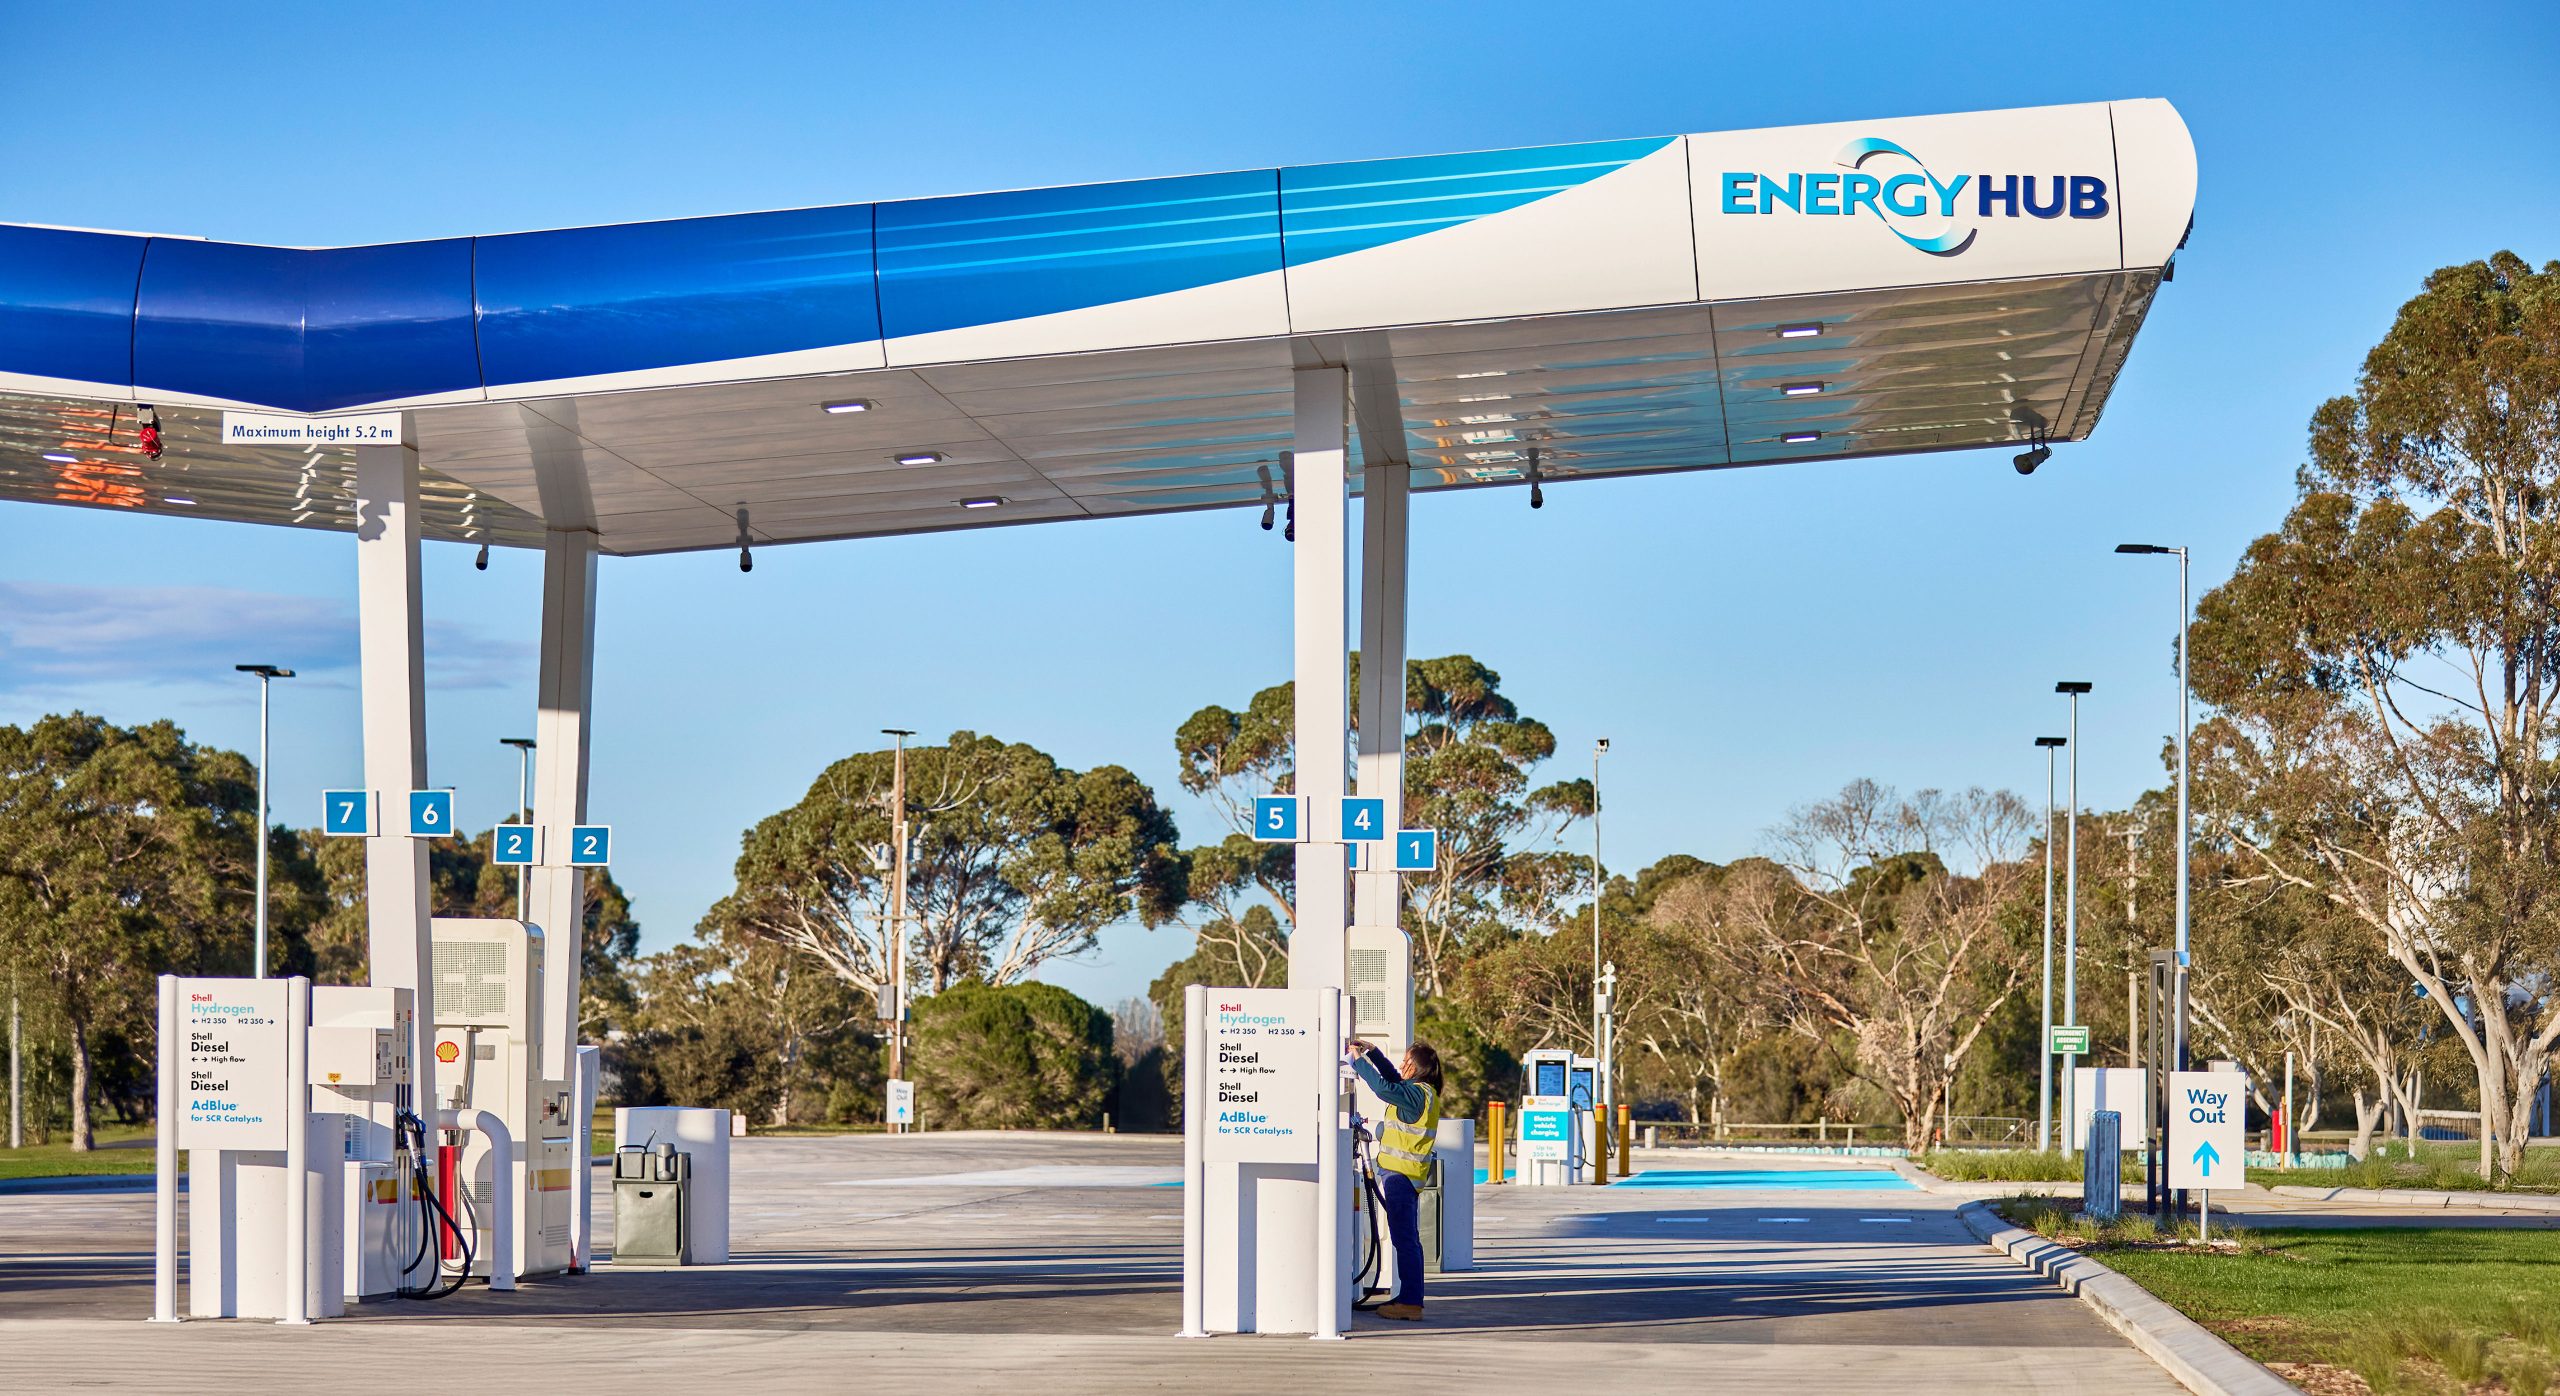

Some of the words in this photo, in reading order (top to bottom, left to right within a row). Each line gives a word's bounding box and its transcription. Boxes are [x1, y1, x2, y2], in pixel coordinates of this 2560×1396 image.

[1721, 171, 1972, 217] ENERGY
[1978, 174, 2110, 219] HUB
[232, 424, 301, 438] Maximum
[307, 424, 350, 441] height
[355, 425, 377, 438] 5.2
[381, 428, 393, 438] m
[338, 801, 354, 824] 7
[422, 802, 439, 825] 6
[1268, 807, 1284, 830] 5
[1354, 808, 1371, 831] 4
[507, 834, 522, 854] 2
[583, 835, 598, 855] 2
[1409, 840, 1420, 860] 1
[191, 994, 213, 1002] Shell
[191, 1003, 255, 1016] Hydrogen
[1220, 1004, 1242, 1012] Shell
[1220, 1013, 1285, 1027] Hydrogen
[191, 1033, 213, 1041] Shell
[191, 1042, 229, 1053] Diesel
[1220, 1043, 1242, 1051] Shell
[211, 1056, 228, 1064] High
[1219, 1052, 1259, 1064] Diesel
[1240, 1067, 1258, 1075] High
[191, 1080, 229, 1091] Diesel
[1219, 1083, 1241, 1091] Shell
[1219, 1092, 1258, 1103] Diesel
[2187, 1088, 2228, 1109] Way
[191, 1100, 237, 1111] AdBlue
[191, 1114, 203, 1122] for
[206, 1115, 221, 1123] SCR
[224, 1115, 263, 1124] Catalysts
[1219, 1112, 1266, 1123] AdBlue
[2189, 1107, 2226, 1124] Out
[1219, 1126, 1231, 1134] for
[1253, 1127, 1293, 1136] Catalysts
